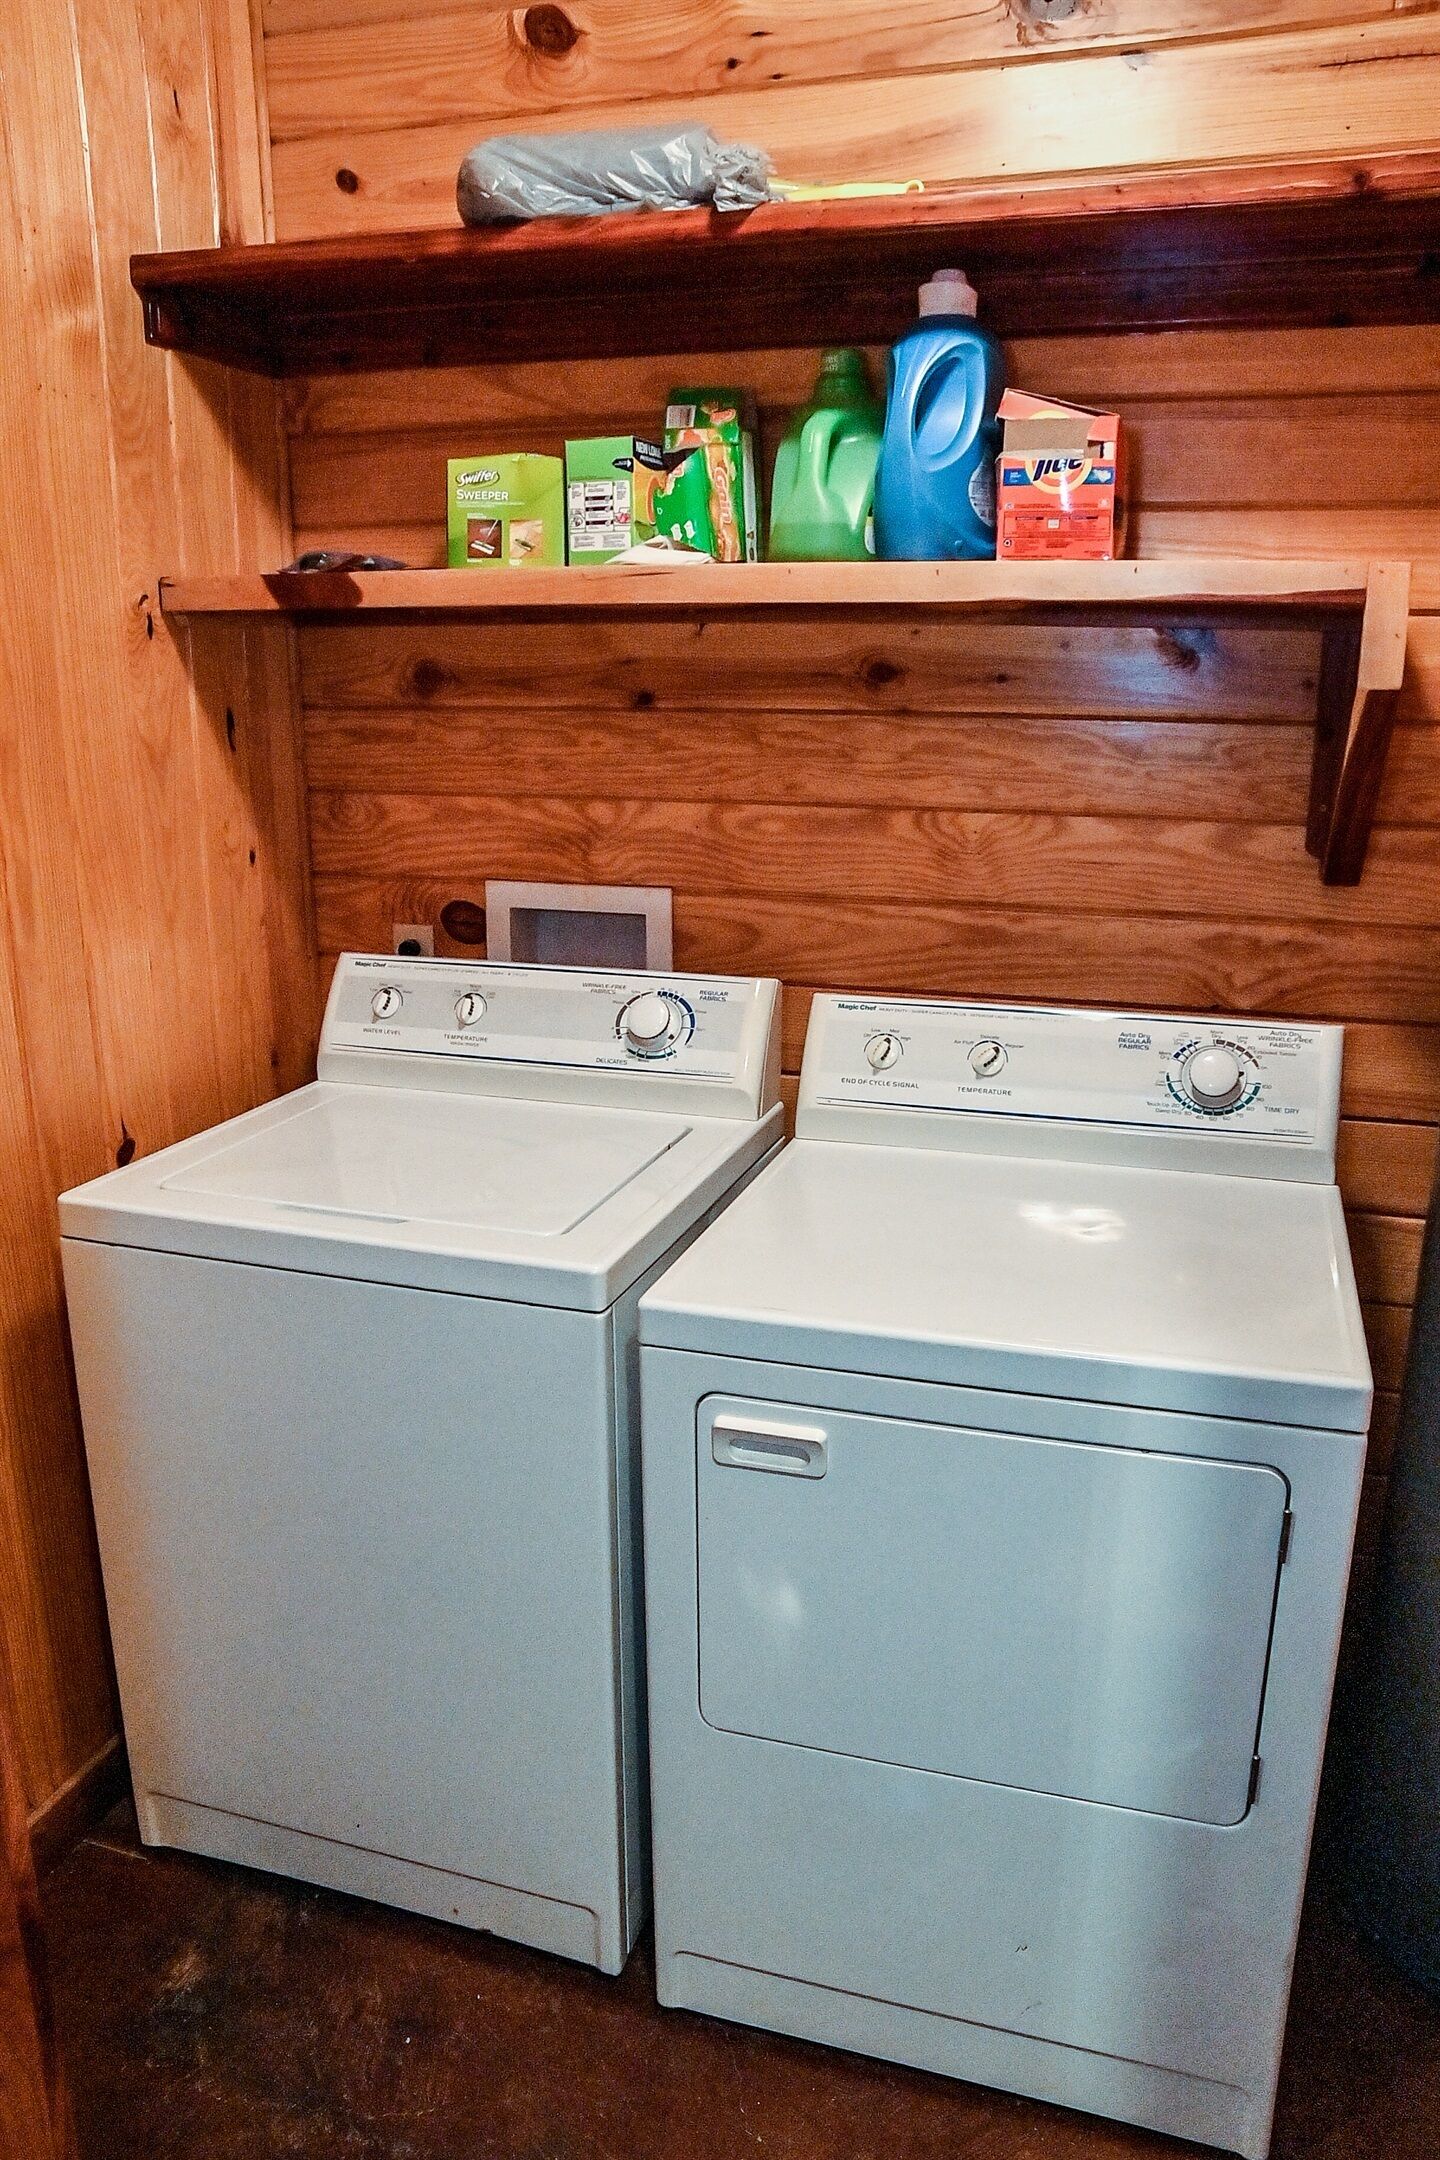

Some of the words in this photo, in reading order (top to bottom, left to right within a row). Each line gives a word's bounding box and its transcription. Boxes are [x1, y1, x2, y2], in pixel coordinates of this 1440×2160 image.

[458, 470, 496, 487] Swiffer
[456, 490, 508, 500] SWEEPER
[838, 1003, 859, 1011] Magic
[444, 1033, 488, 1042] TEMPERATURE
[1258, 1036, 1313, 1044] WRINKLE-FREE
[596, 1057, 628, 1065] DELICATES
[958, 1086, 1012, 1096] TEMPERATURE
